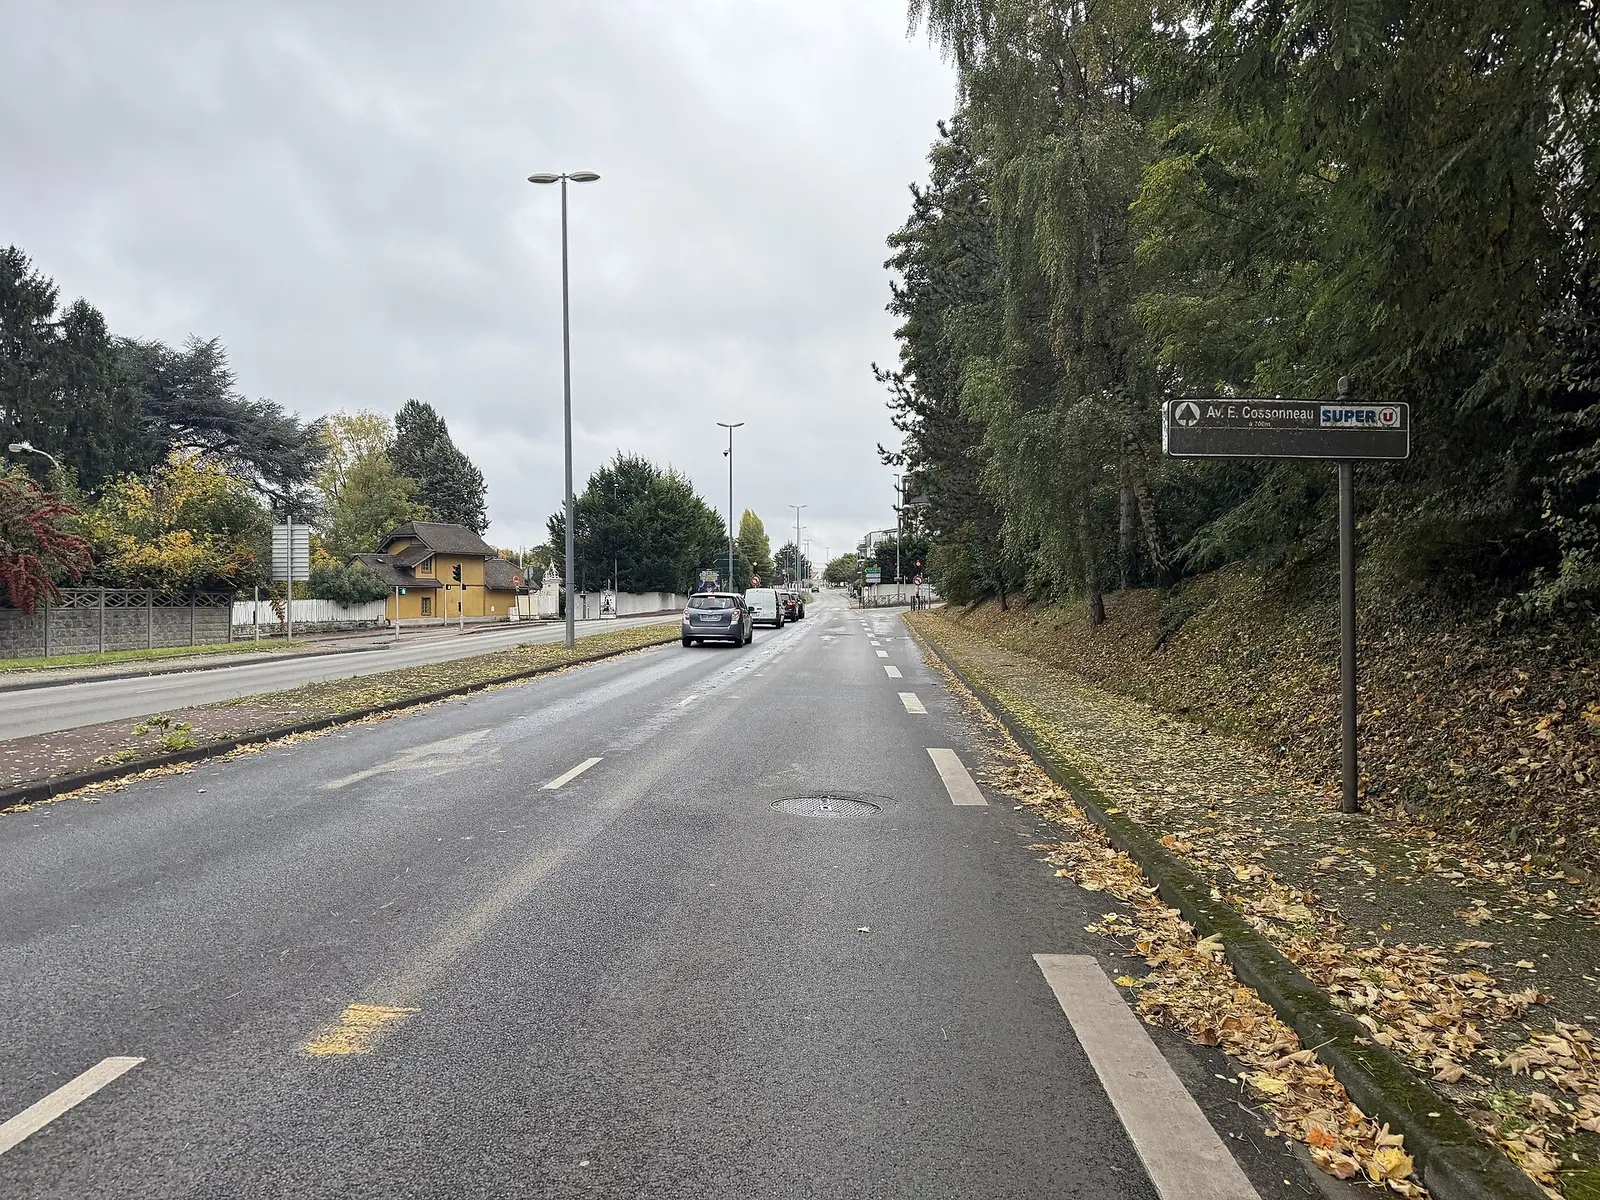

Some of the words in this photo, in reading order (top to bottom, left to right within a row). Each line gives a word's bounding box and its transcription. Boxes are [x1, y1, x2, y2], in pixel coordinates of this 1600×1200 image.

[1206, 405, 1223, 418] Av.
[1228, 405, 1238, 419] E.
[1242, 405, 1314, 420] Cossonneau
[1322, 409, 1378, 424] SUPER
[1383, 411, 1394, 422] U
